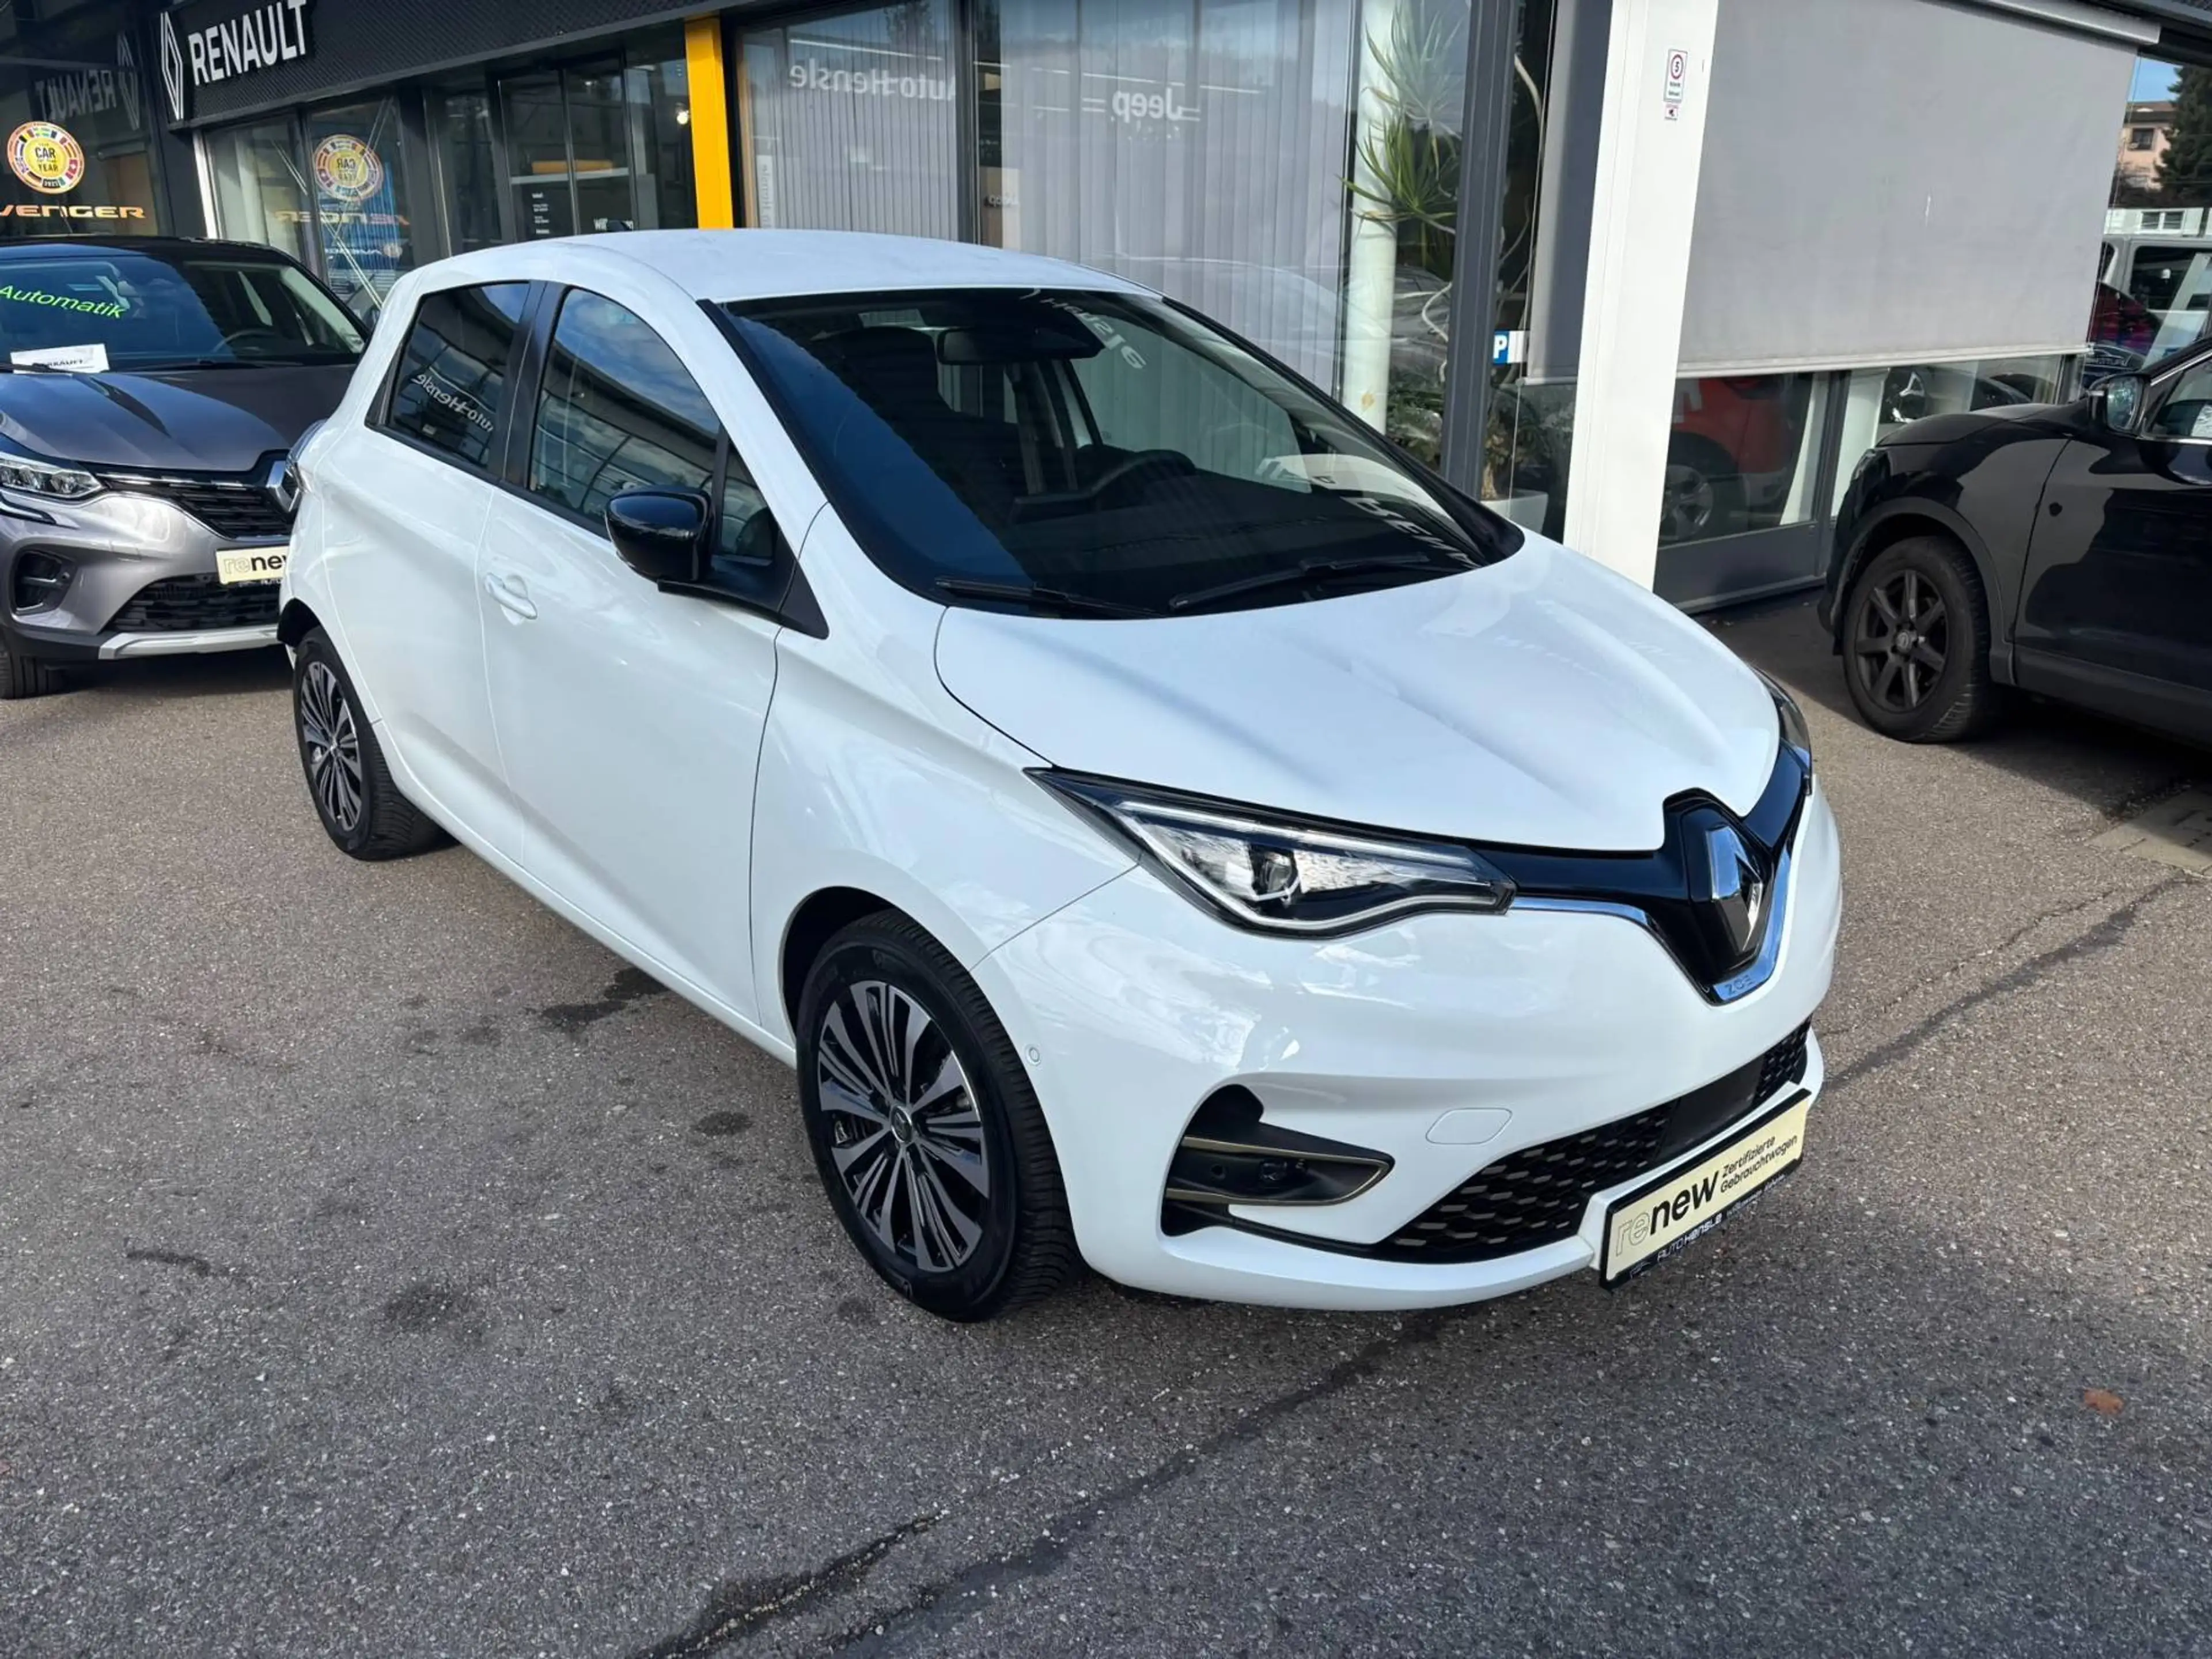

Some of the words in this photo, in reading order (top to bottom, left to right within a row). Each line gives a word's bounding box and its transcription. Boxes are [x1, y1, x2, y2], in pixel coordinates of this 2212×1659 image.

[188, 0, 306, 86] RENAULT
[35, 147, 56, 158] CAR
[0, 285, 126, 319] Automatik
[1493, 335, 1508, 359] P
[1720, 1135, 1798, 1193] Gebrauchtwagen
[1722, 1135, 1776, 1178] Zertifizierte
[1615, 1170, 1719, 1257] renew
